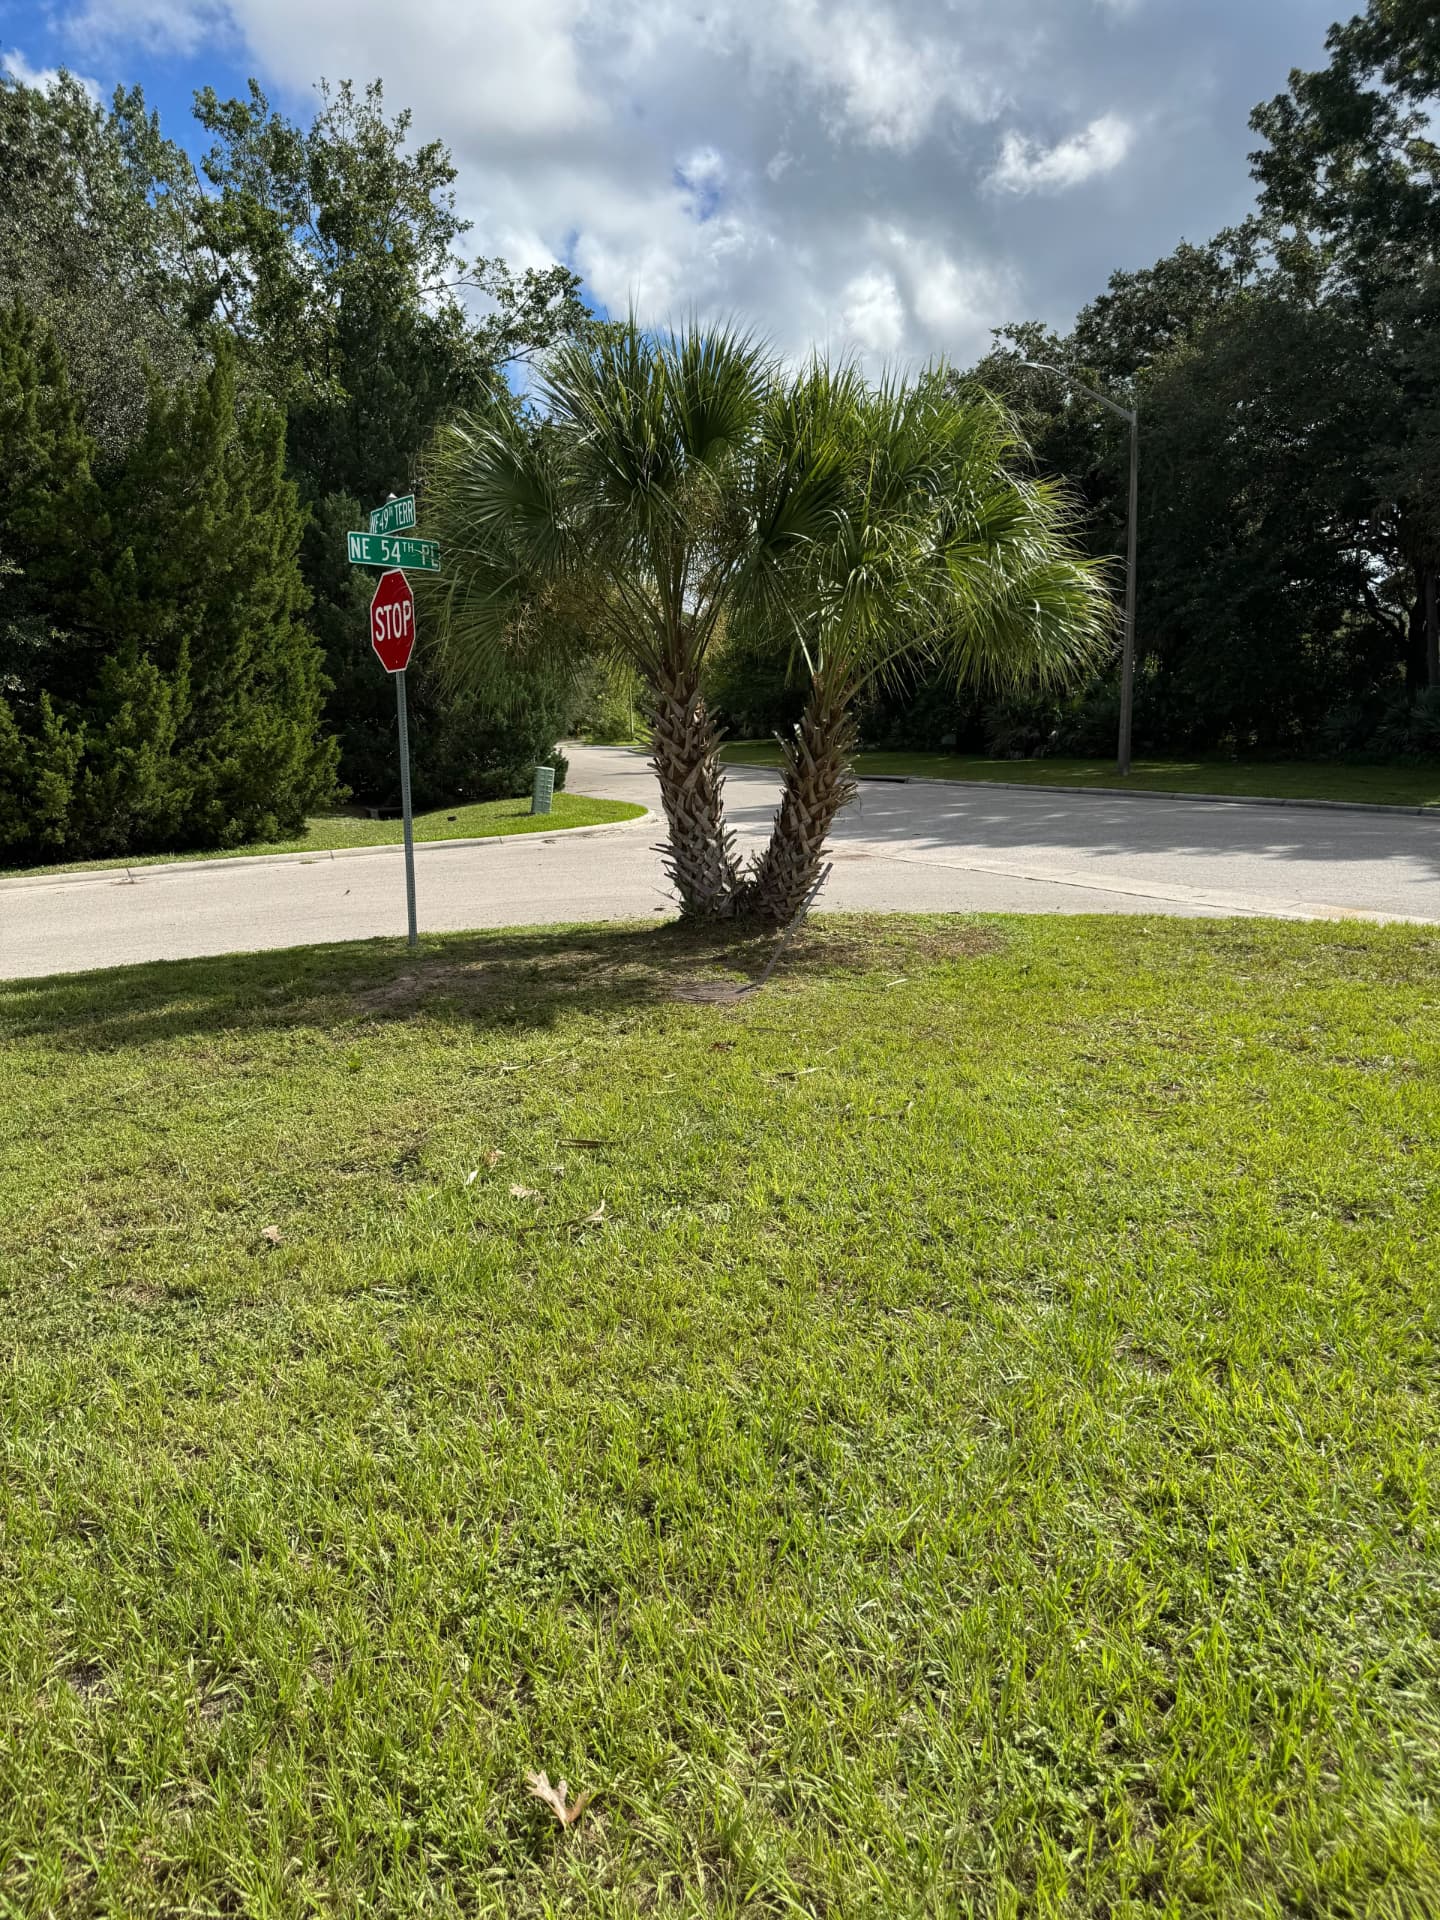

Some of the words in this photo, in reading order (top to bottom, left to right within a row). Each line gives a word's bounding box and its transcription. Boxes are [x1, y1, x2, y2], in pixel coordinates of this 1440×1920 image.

[370, 510, 380, 534] NE
[394, 500, 414, 527] TERR
[350, 536, 371, 560] NE
[381, 539, 414, 563] 54TH
[421, 544, 439, 568] PL
[375, 600, 412, 642] STOP
